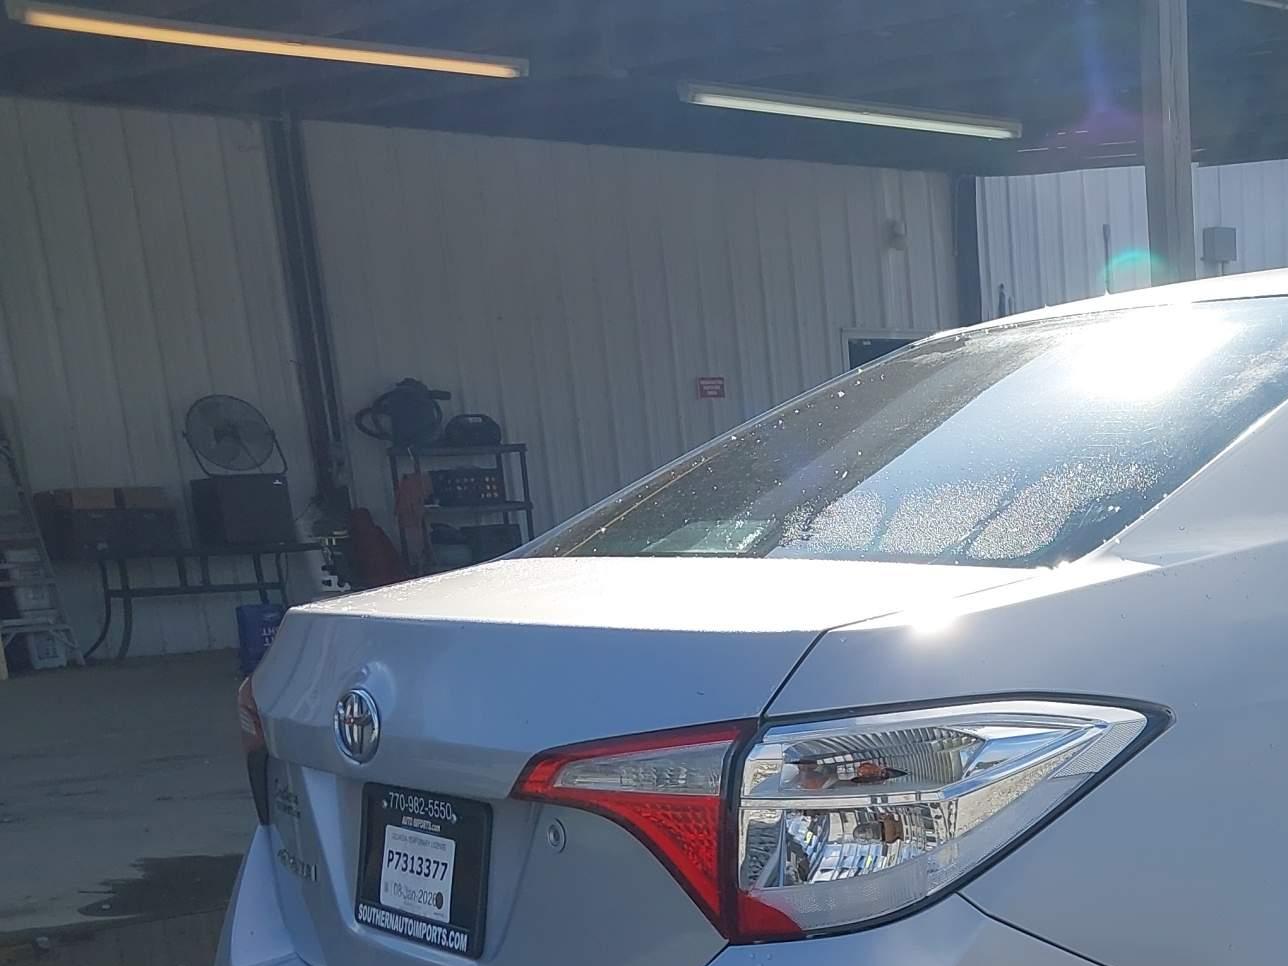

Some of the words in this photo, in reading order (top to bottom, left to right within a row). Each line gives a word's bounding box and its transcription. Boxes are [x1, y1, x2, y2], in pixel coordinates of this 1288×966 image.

[389, 792, 452, 820] 770-982-5550
[387, 850, 448, 881] P7313377
[358, 903, 467, 953] SOUTHERNAUTOIMPORTS.COM
